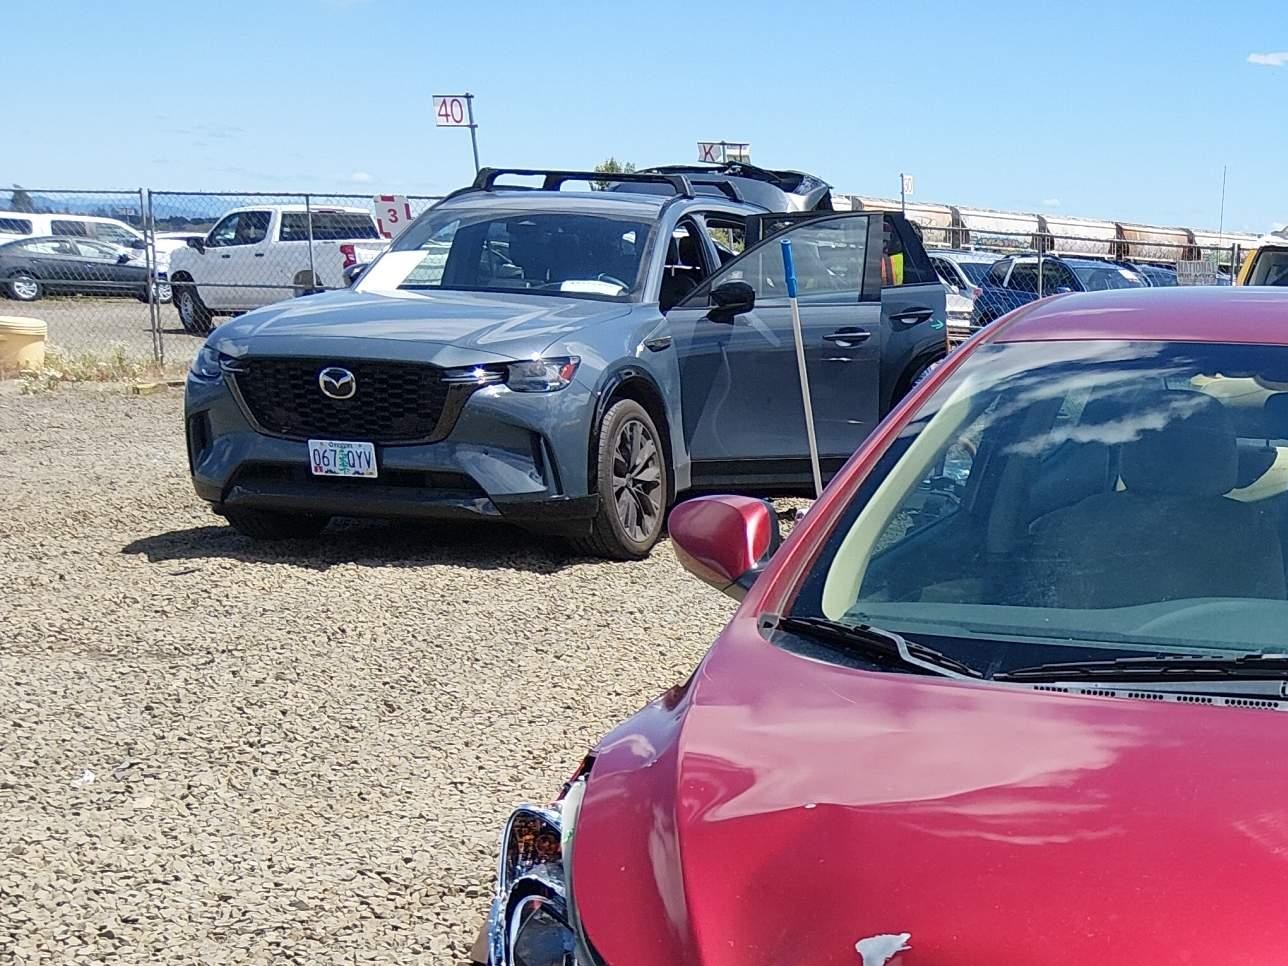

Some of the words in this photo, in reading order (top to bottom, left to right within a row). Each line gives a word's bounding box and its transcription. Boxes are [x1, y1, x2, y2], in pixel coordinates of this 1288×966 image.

[438, 98, 464, 123] 40
[703, 144, 716, 161] K
[387, 208, 398, 223] 3
[313, 449, 338, 468] 067
